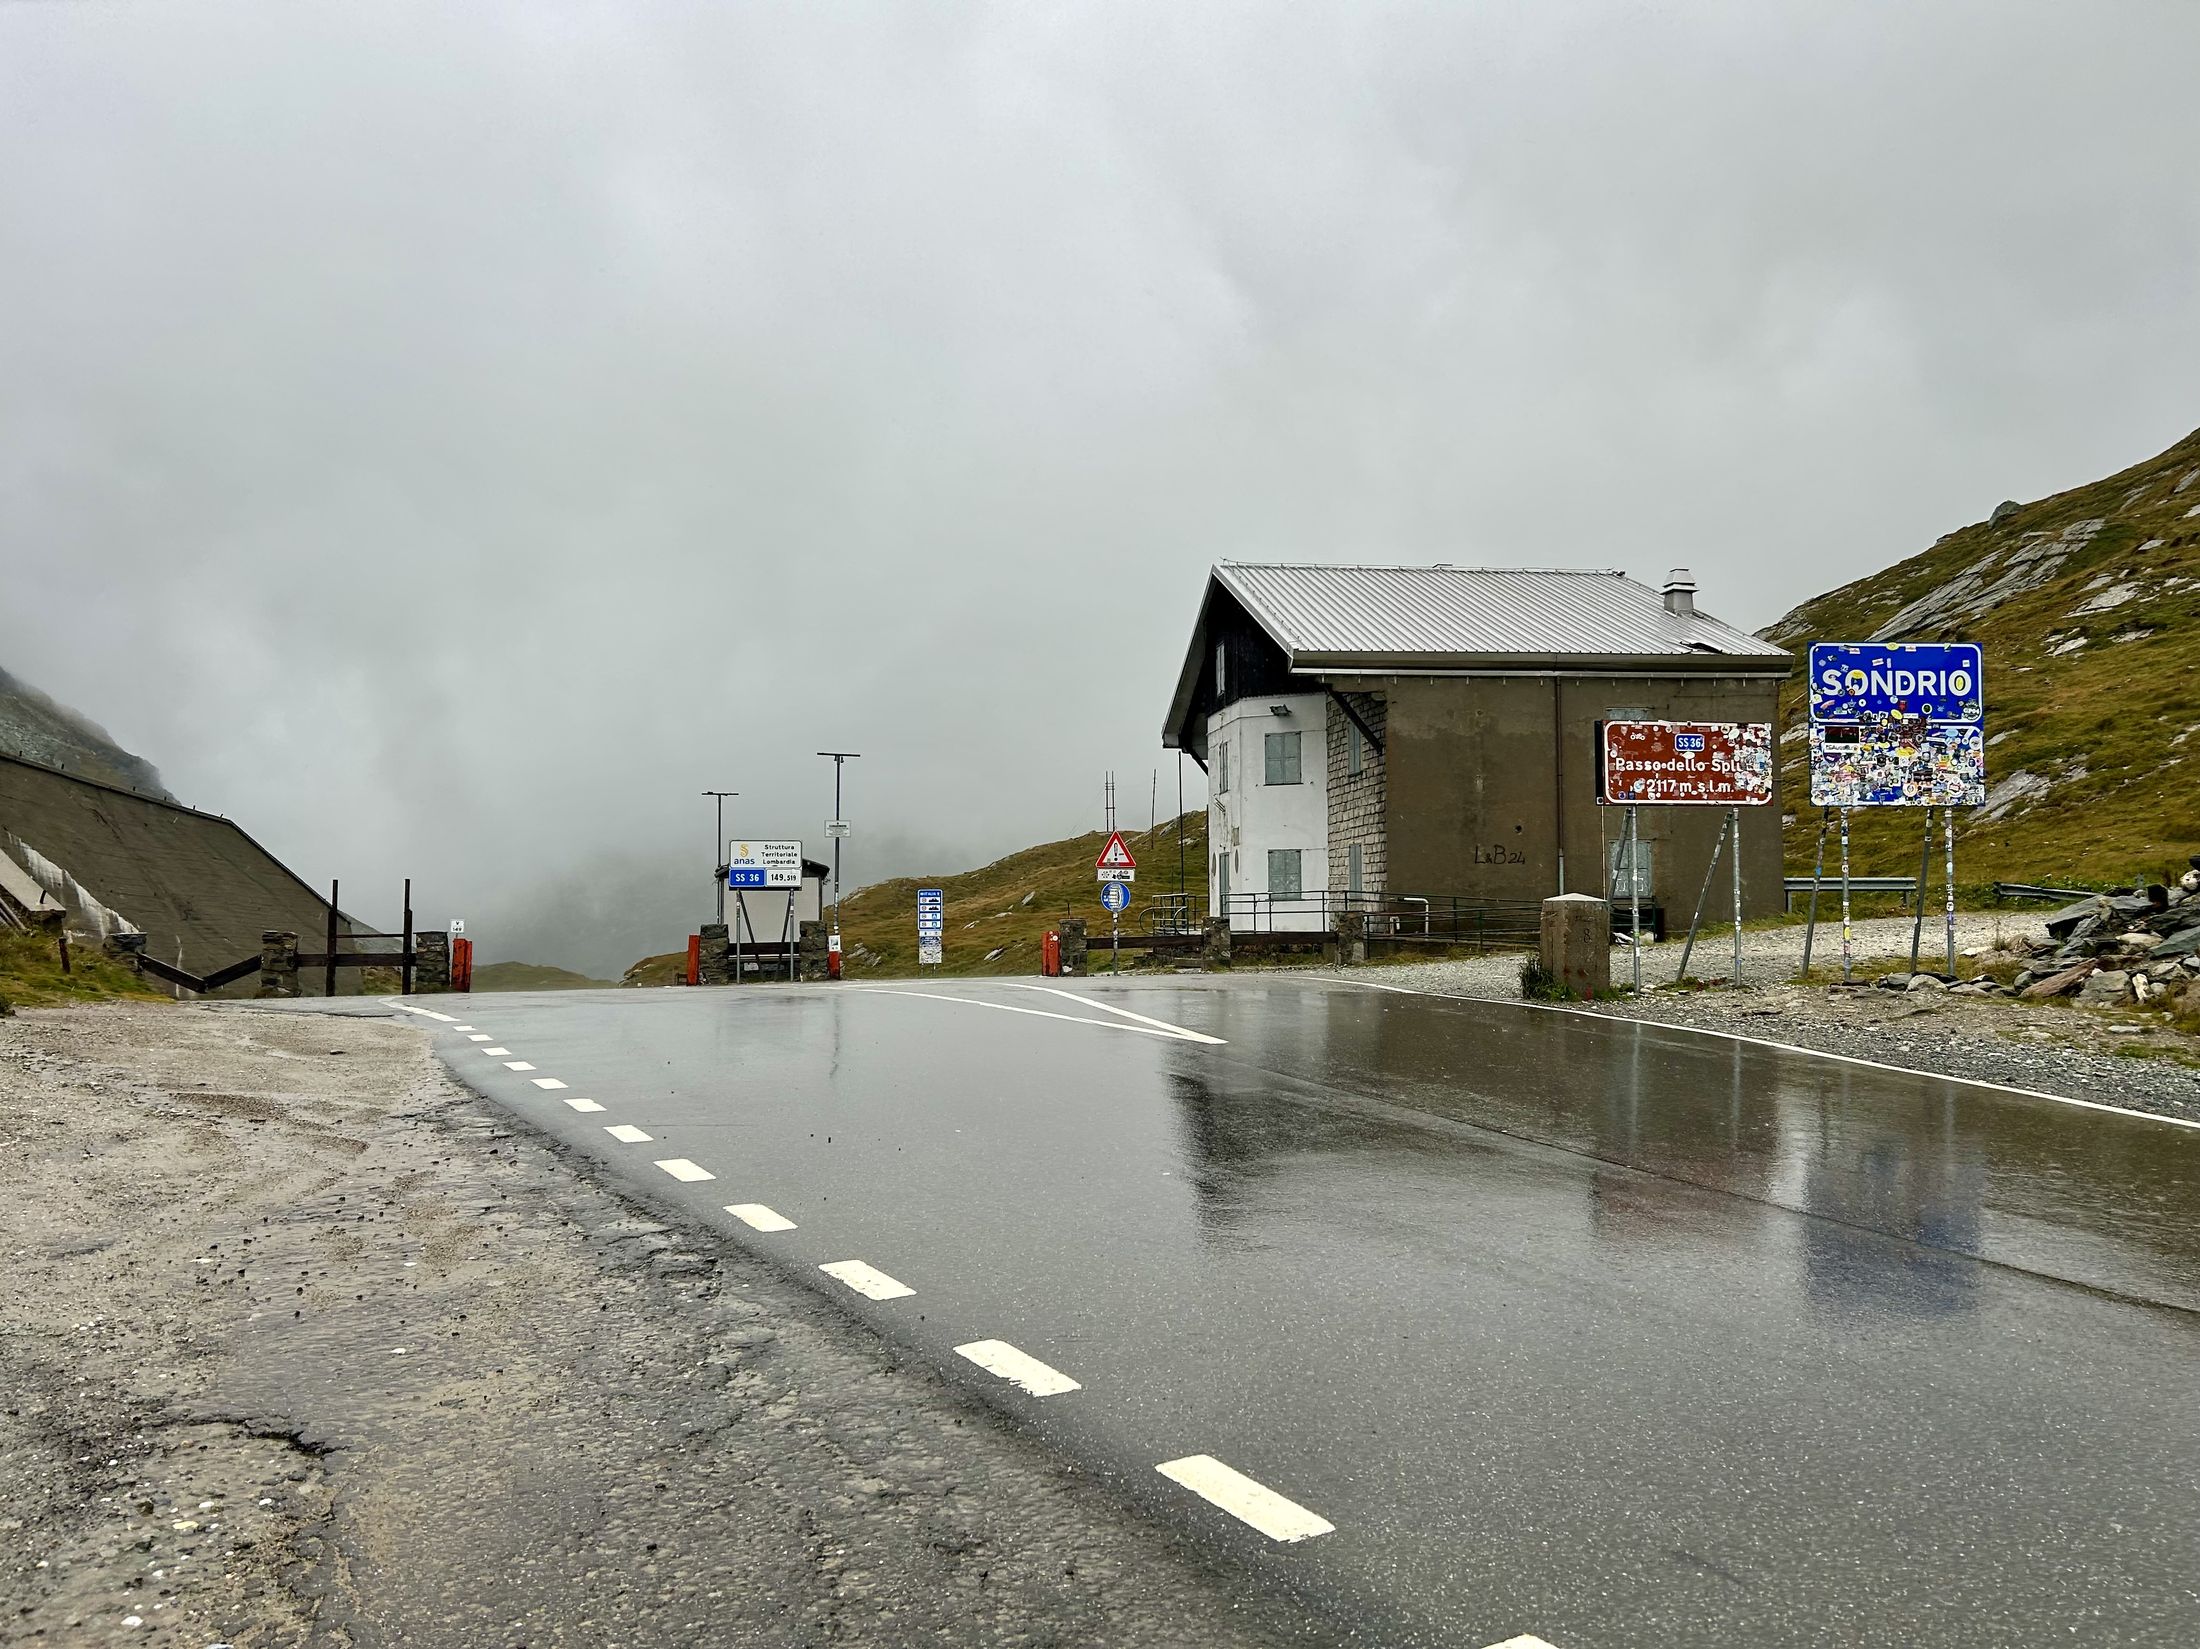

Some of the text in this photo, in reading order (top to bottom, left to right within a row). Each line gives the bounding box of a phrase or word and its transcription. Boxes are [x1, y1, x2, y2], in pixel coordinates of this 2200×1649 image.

[1822, 669, 1972, 696] SONDRIO
[1678, 737, 1701, 748] SS 36
[1615, 758, 1661, 772] Passo
[1667, 758, 1705, 772] dello
[1646, 779, 1676, 793] 2117
[735, 873, 760, 882] SS 36
